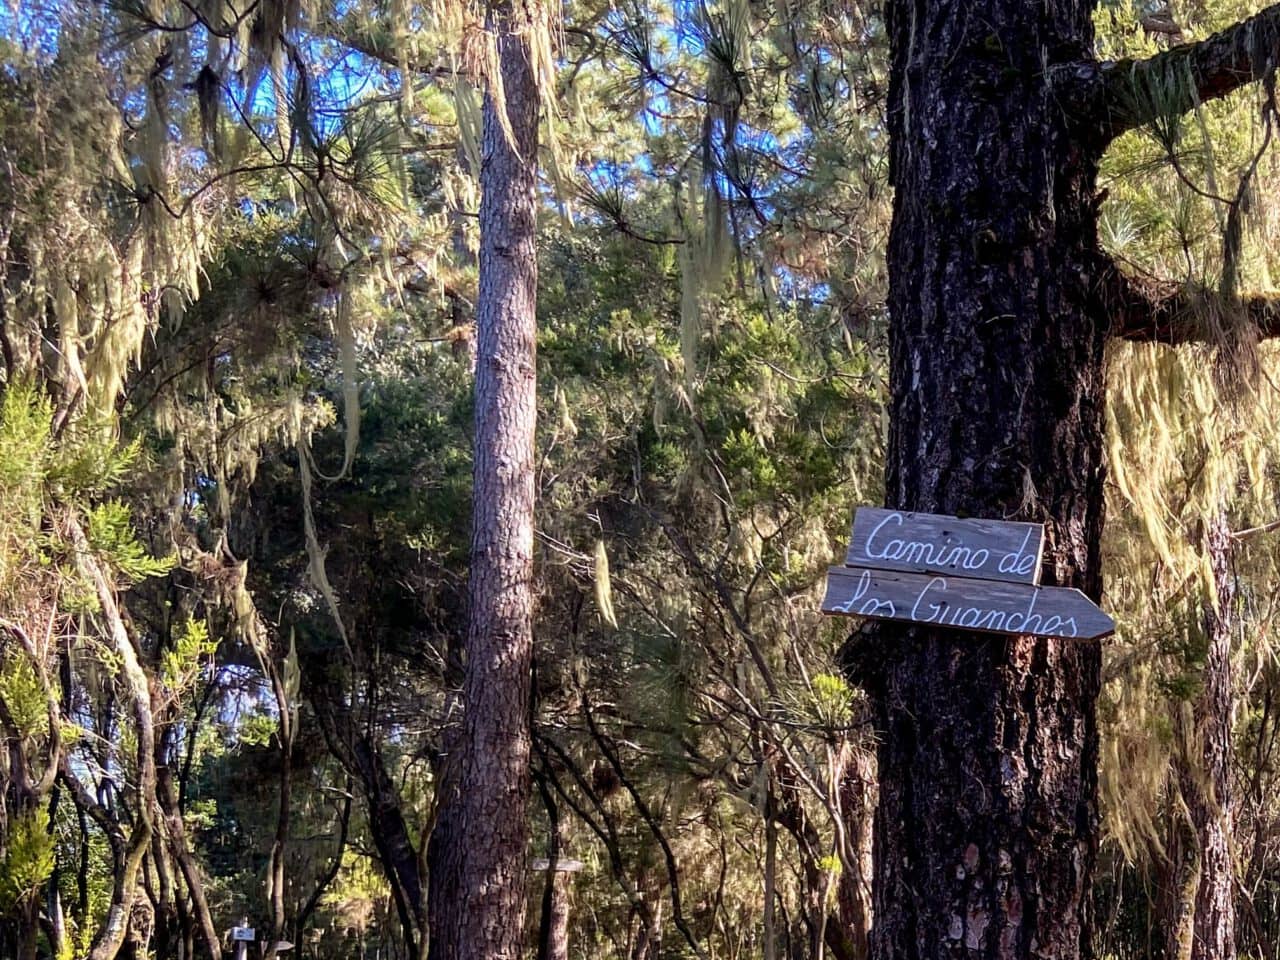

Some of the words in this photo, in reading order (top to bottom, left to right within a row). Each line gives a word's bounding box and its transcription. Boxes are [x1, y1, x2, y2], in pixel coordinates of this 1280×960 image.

[865, 513, 990, 570] Camino
[998, 526, 1035, 575] de
[911, 577, 1079, 638] Guanches
